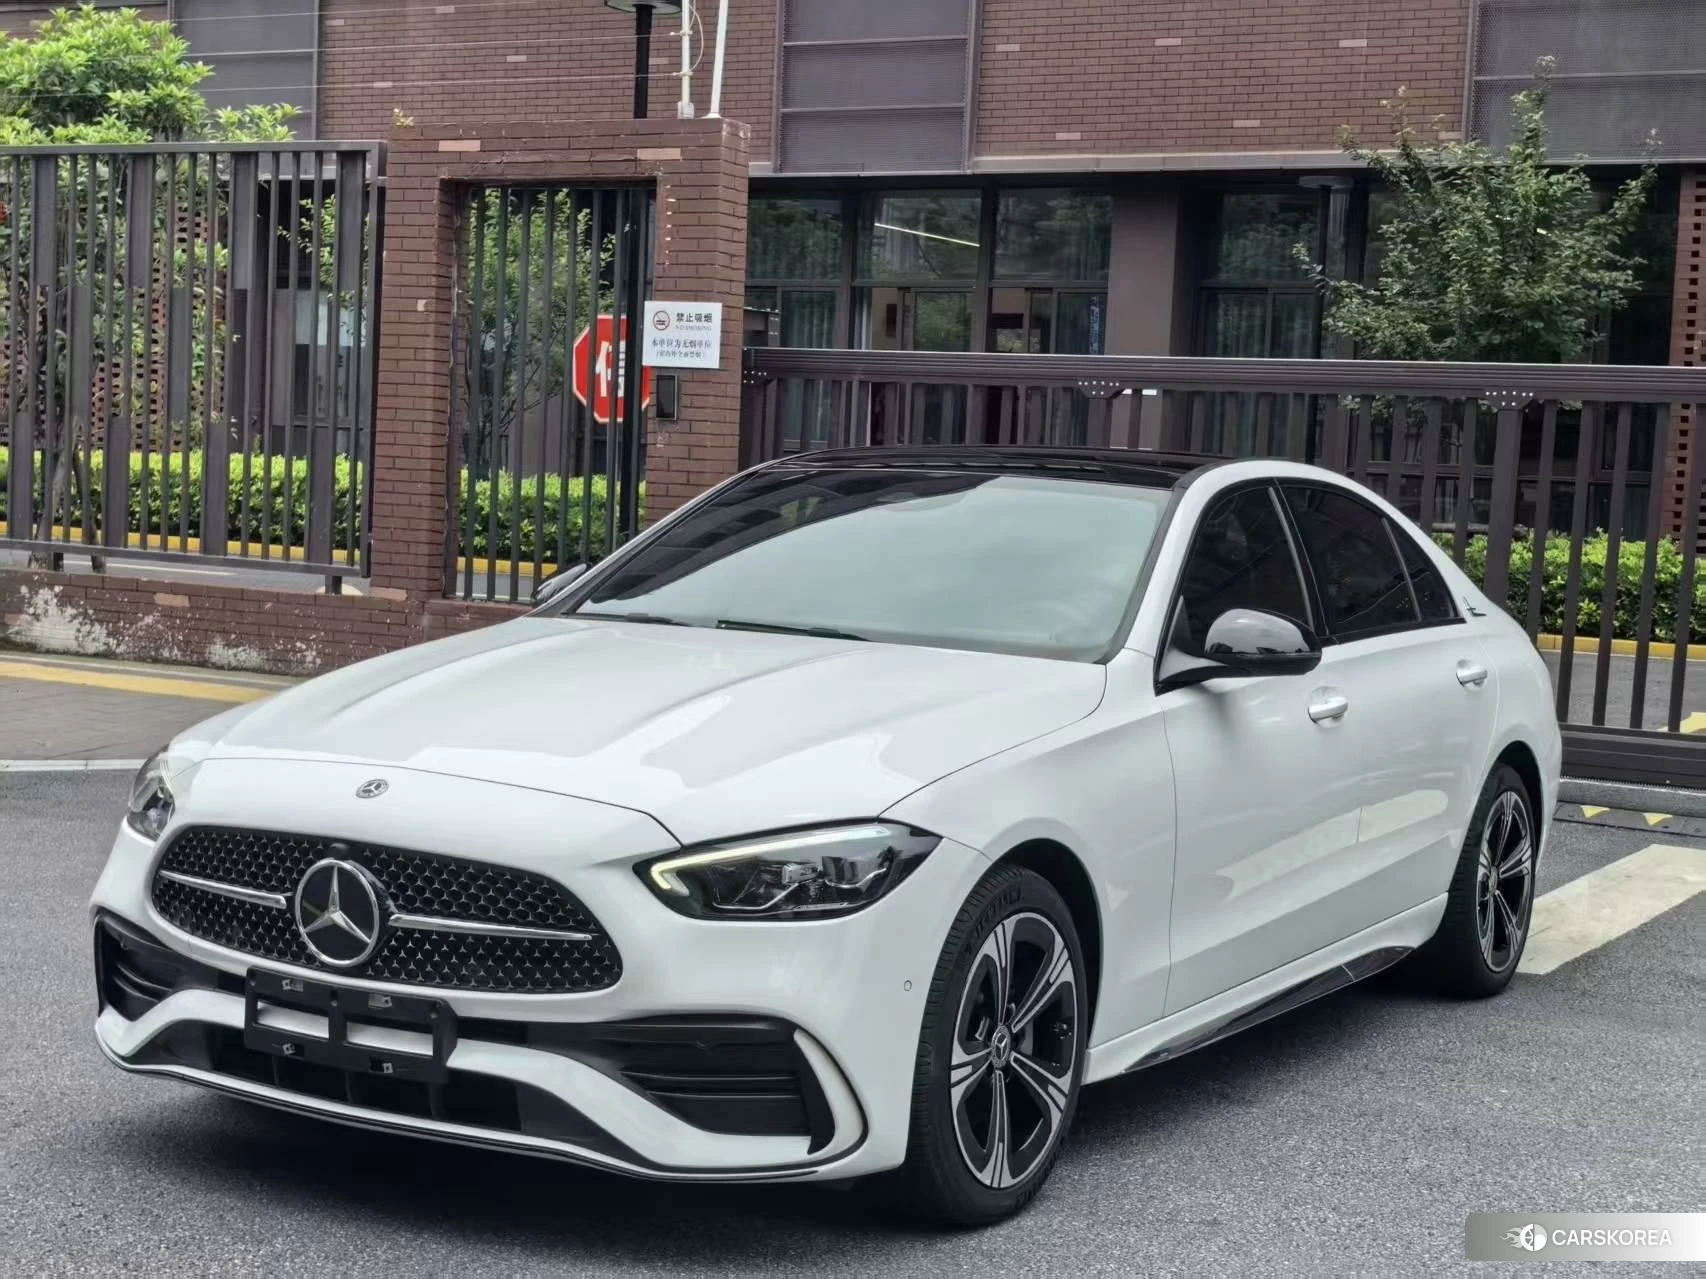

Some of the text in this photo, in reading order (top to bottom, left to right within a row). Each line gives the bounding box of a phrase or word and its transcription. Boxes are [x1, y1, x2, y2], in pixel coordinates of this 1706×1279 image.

[676, 312, 713, 323] 禁止吸烟
[652, 338, 712, 349] 本单位为无烟单位
